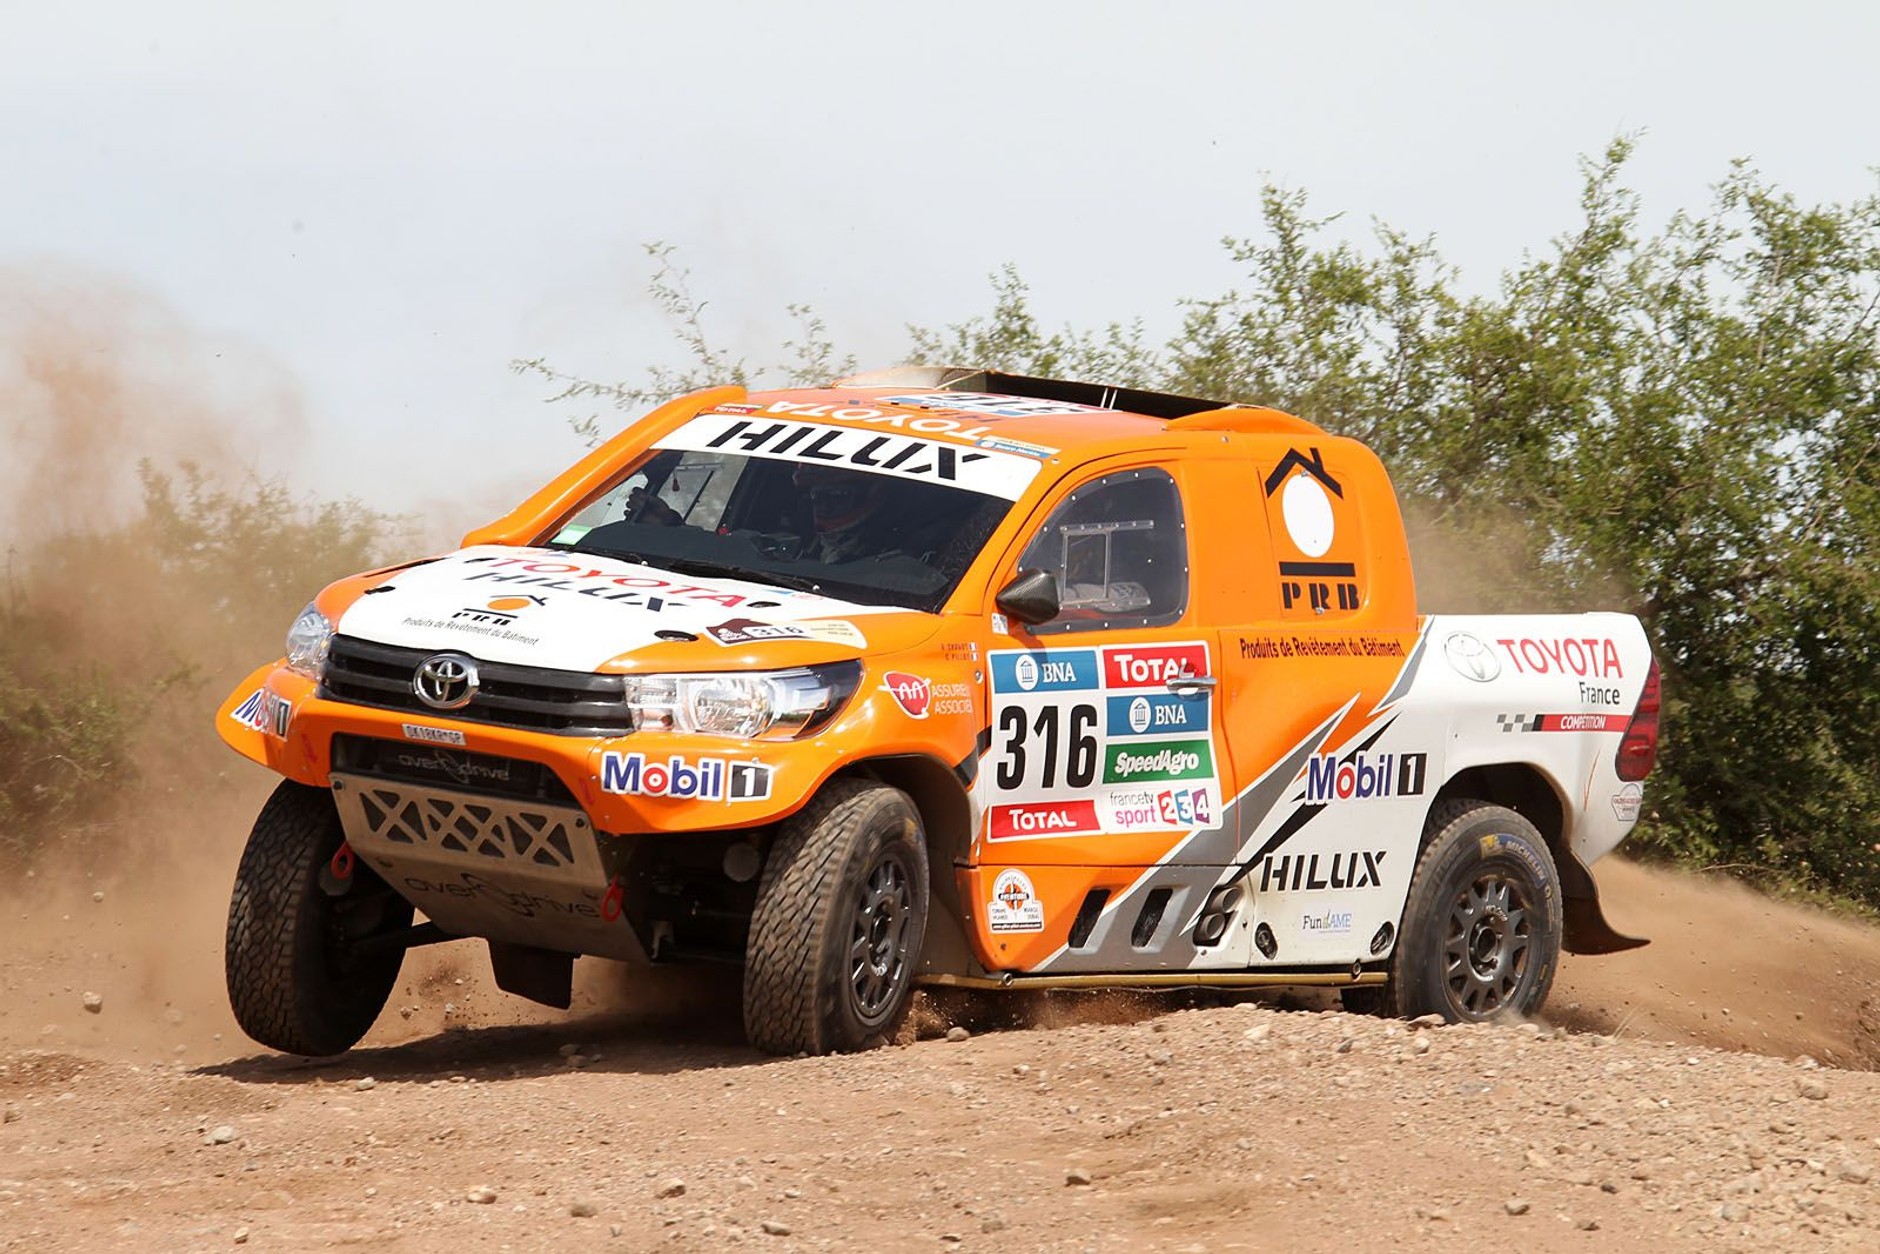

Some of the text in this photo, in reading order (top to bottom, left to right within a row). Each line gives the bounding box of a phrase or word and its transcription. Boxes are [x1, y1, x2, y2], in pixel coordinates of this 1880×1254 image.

[767, 400, 992, 441] TOYOTA
[705, 420, 991, 481] HILUX
[464, 572, 687, 612] HILUX
[488, 557, 747, 608] TOYOTA
[1282, 582, 1360, 610] PRB
[402, 616, 434, 628] Produits
[490, 627, 503, 638] du
[1239, 637, 1279, 659] Produits
[1279, 637, 1294, 657] de
[1349, 637, 1364, 656] du
[1495, 638, 1624, 679] TOYOTA
[1042, 661, 1077, 684] BNA
[1113, 653, 1197, 683] TOTAL
[1578, 681, 1621, 705] France
[1154, 704, 1187, 726] BNA
[996, 703, 1098, 791] 316
[603, 755, 722, 797] Mobil
[1114, 749, 1200, 777] SpeedAgro
[1307, 753, 1394, 800] Mobil
[1109, 791, 1154, 808] francetv
[1008, 808, 1078, 831] TOTAL
[1115, 805, 1157, 828] sport
[1259, 850, 1388, 892] HILUX
